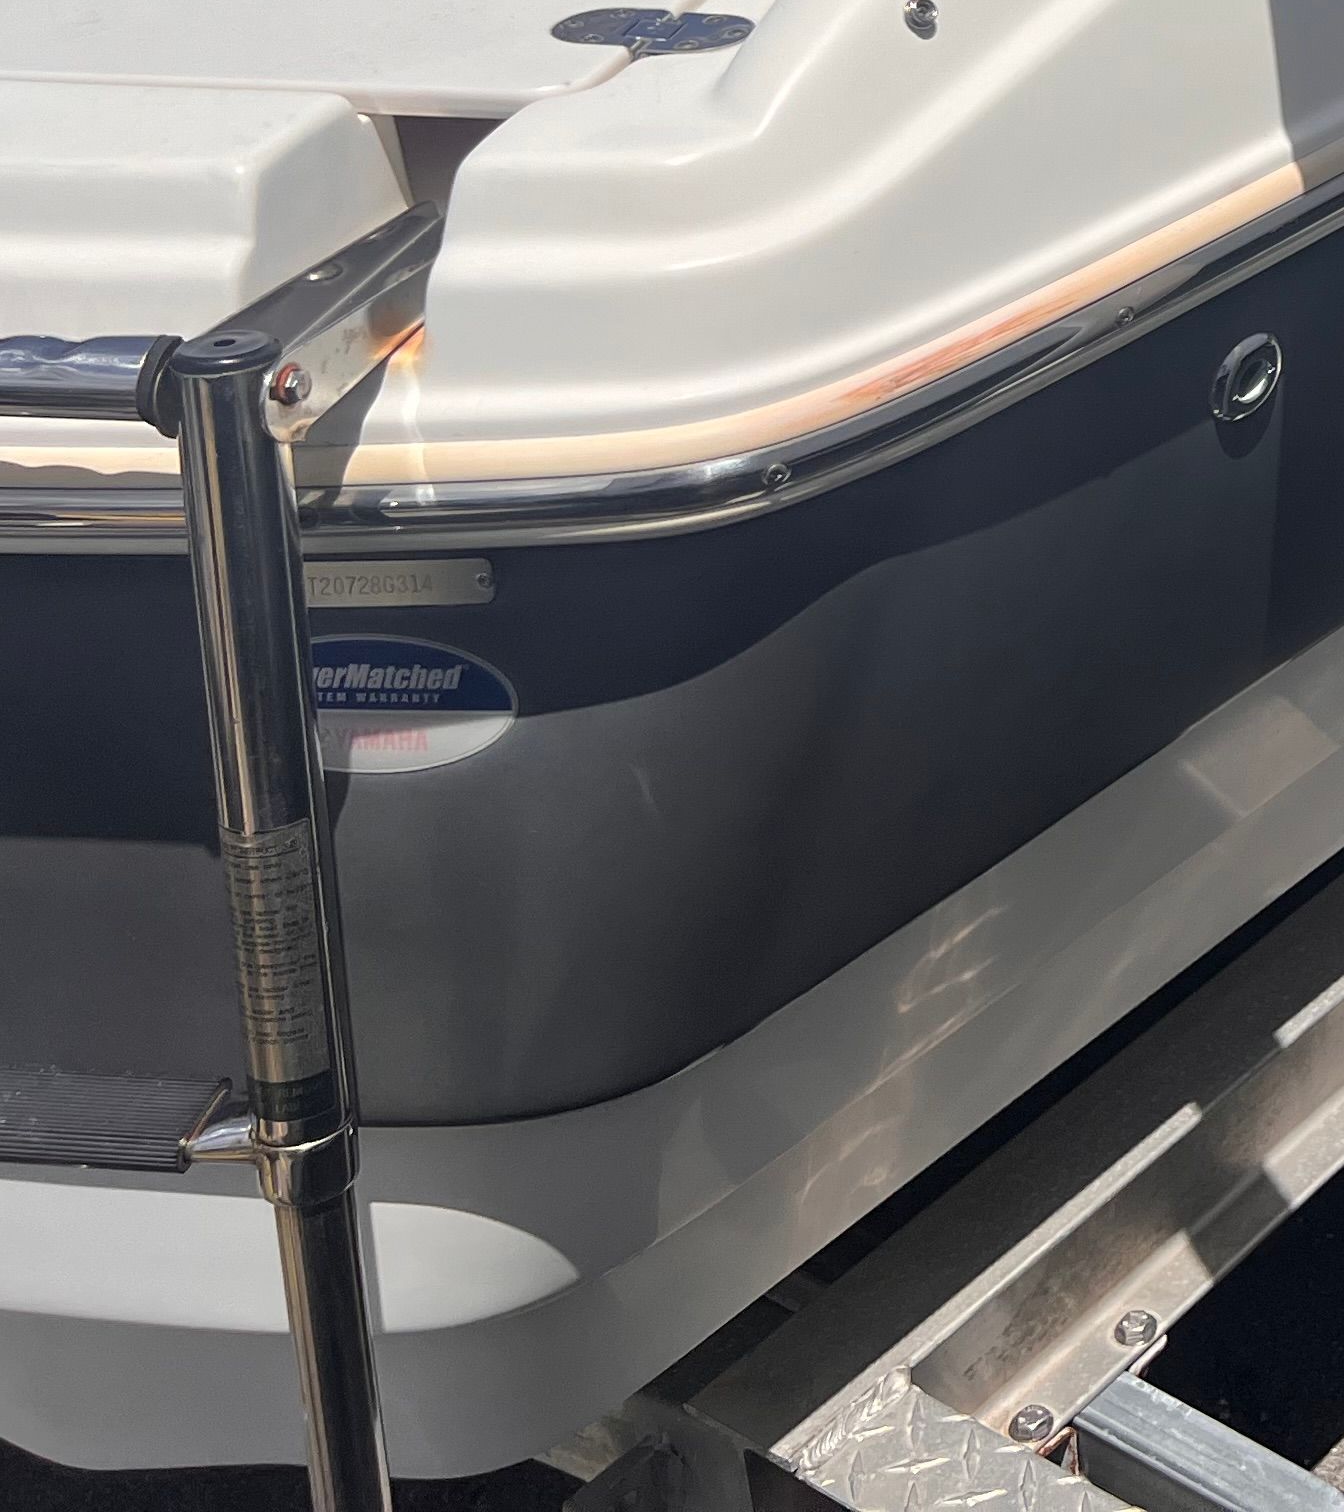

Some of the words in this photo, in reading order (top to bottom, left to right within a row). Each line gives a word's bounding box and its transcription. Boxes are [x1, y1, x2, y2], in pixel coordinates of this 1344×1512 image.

[313, 664, 463, 690] erMatched
[356, 691, 441, 704] WARRANTY
[336, 727, 429, 752] YAMAHA
